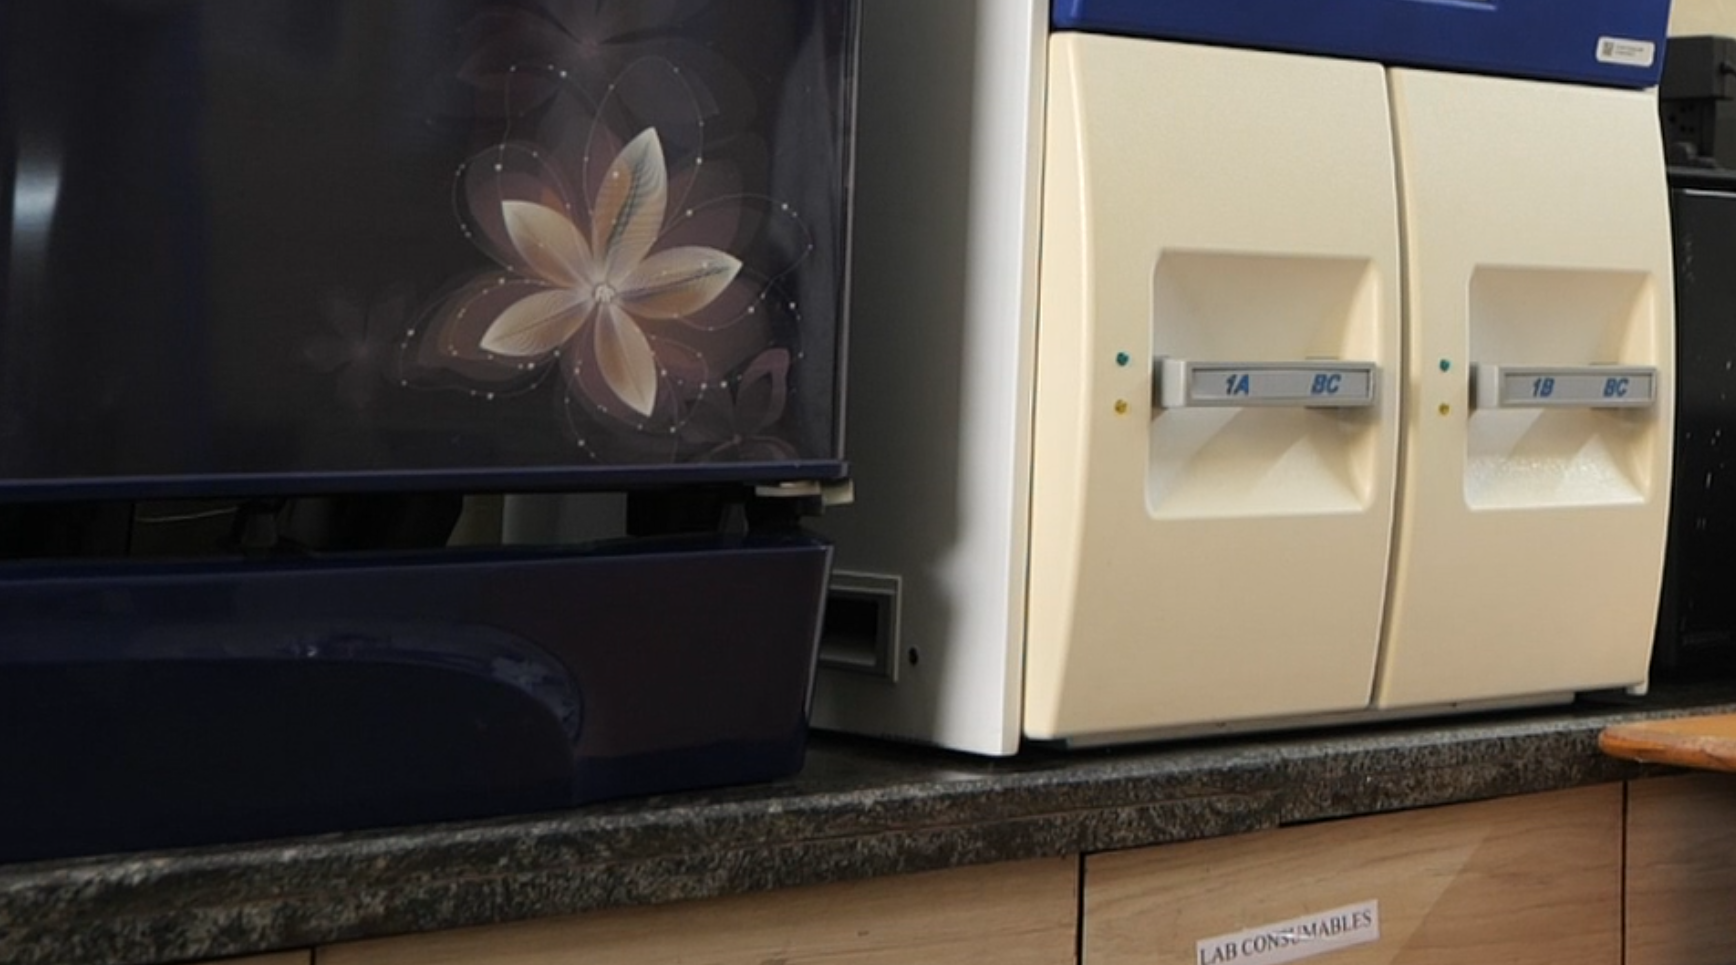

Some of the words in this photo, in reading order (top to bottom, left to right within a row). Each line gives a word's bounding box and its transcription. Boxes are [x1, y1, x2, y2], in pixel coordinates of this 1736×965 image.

[1225, 373, 1249, 395] 1A
[1311, 373, 1342, 395] BC
[1532, 377, 1555, 398] 1B
[1603, 377, 1629, 398] BC
[1200, 941, 1237, 965] LAB
[1241, 909, 1373, 957] CONSUMABLES
